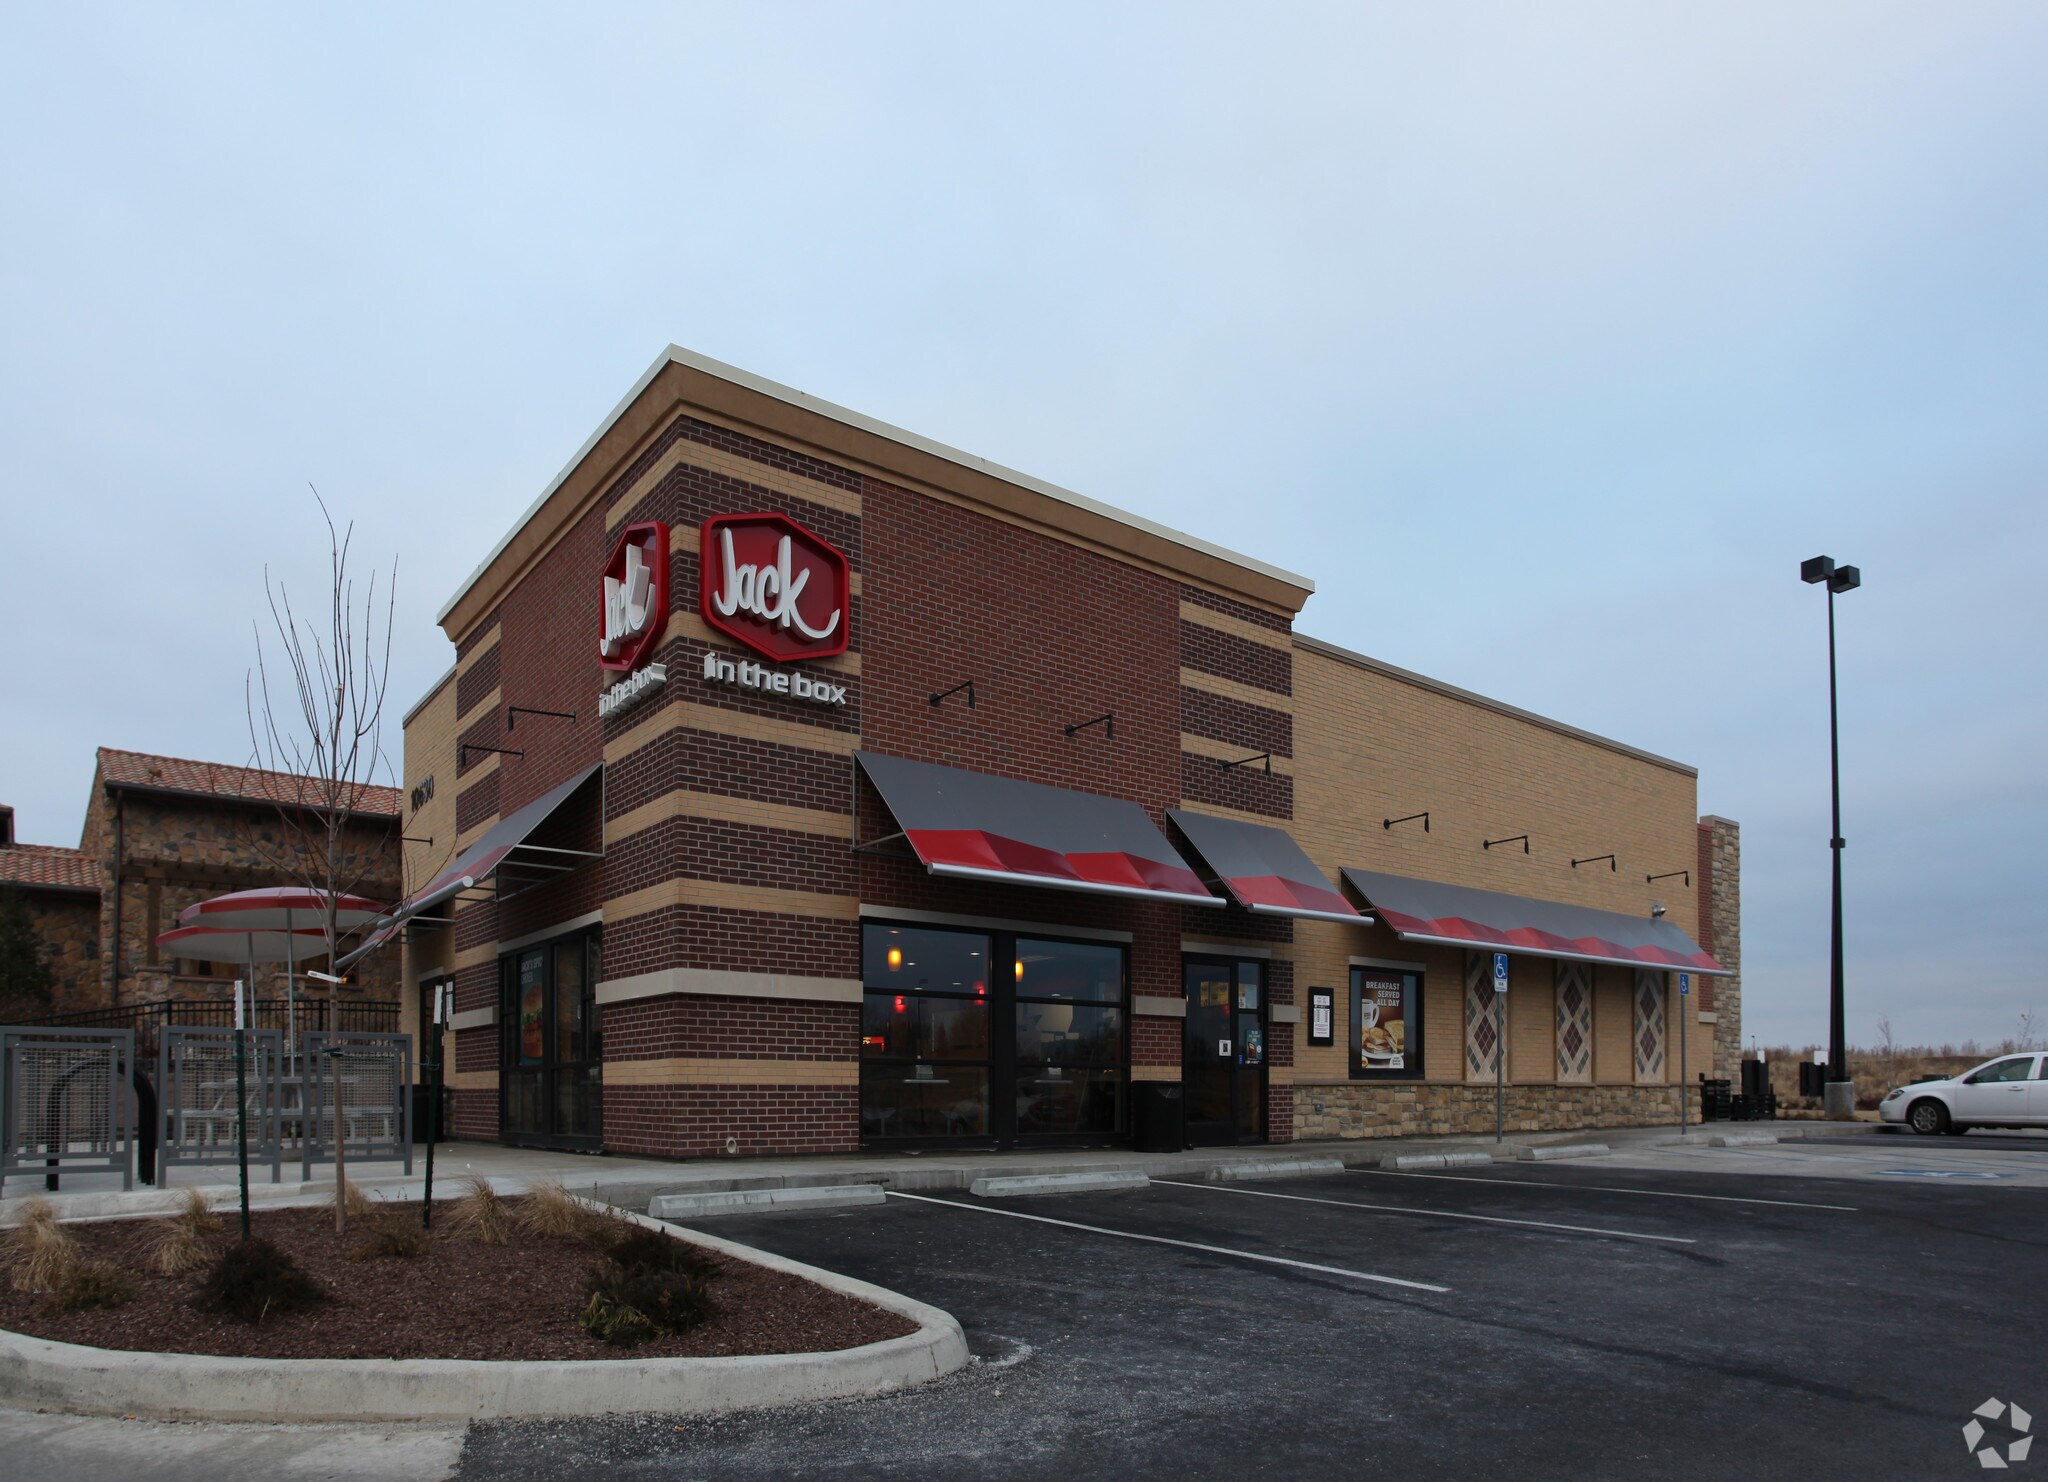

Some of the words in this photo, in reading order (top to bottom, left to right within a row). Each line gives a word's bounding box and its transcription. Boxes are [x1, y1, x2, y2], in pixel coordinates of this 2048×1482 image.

[711, 526, 841, 640] Jack
[703, 651, 736, 684] in
[737, 659, 790, 696] the
[790, 671, 847, 706] box
[1365, 980, 1400, 991] BREAKFAST
[1377, 990, 1400, 999] SERVED
[1376, 998, 1387, 1007] ALL
[1388, 999, 1400, 1007] DAY
